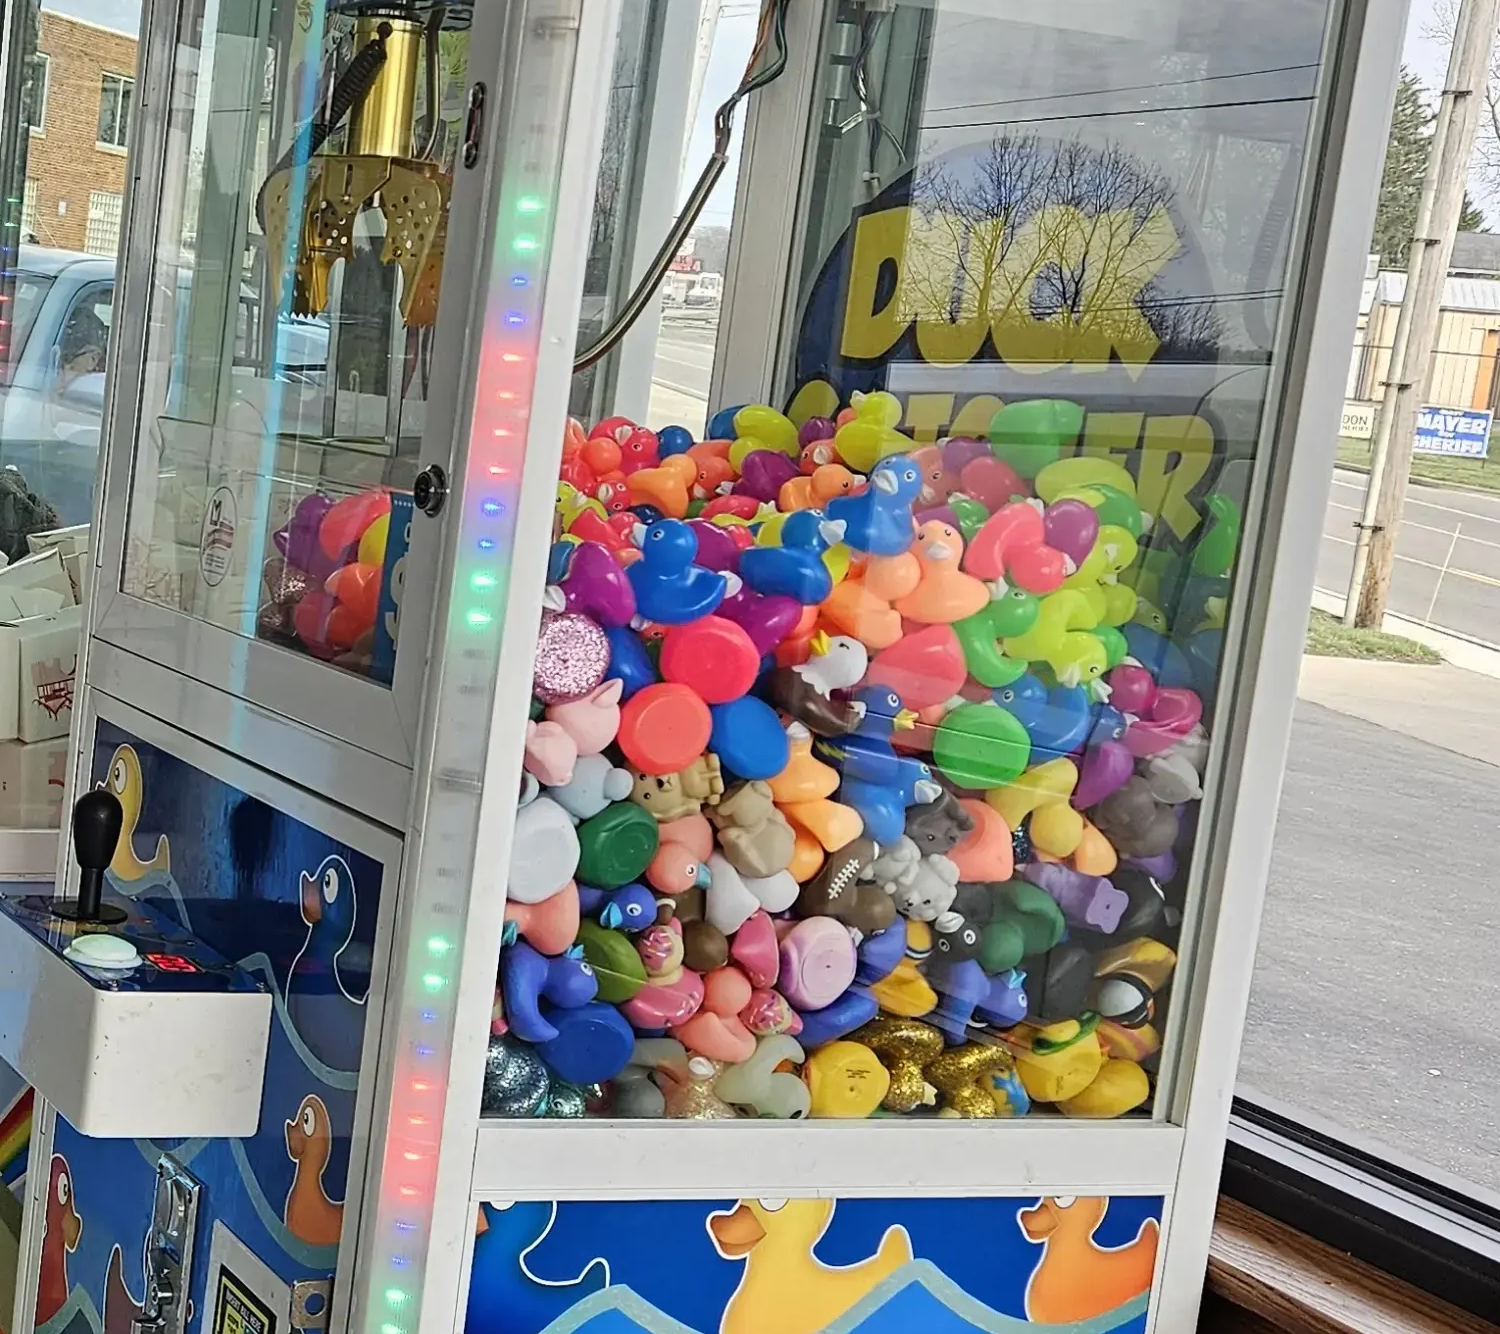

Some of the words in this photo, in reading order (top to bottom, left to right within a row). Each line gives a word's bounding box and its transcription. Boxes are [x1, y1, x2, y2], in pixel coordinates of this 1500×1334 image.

[840, 204, 1182, 383] DUCK
[1415, 412, 1487, 435] MAYER
[1412, 433, 1483, 455] SHERIFF
